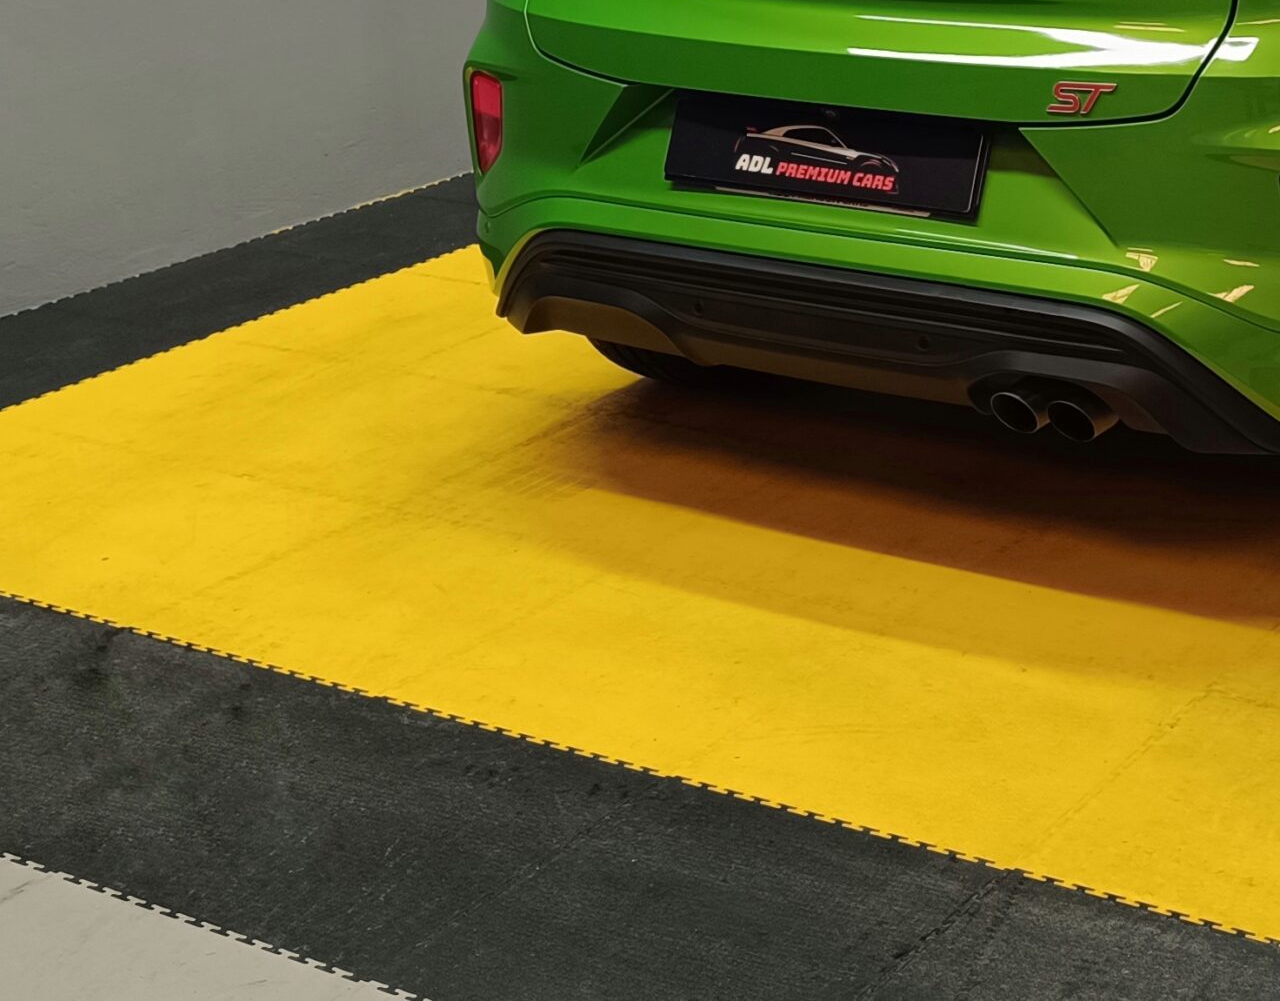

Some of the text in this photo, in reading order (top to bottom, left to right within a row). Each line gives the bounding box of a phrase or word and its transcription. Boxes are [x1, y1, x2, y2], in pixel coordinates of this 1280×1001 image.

[1046, 81, 1118, 115] ST
[735, 153, 896, 192] ADL PREMIUM CARS
